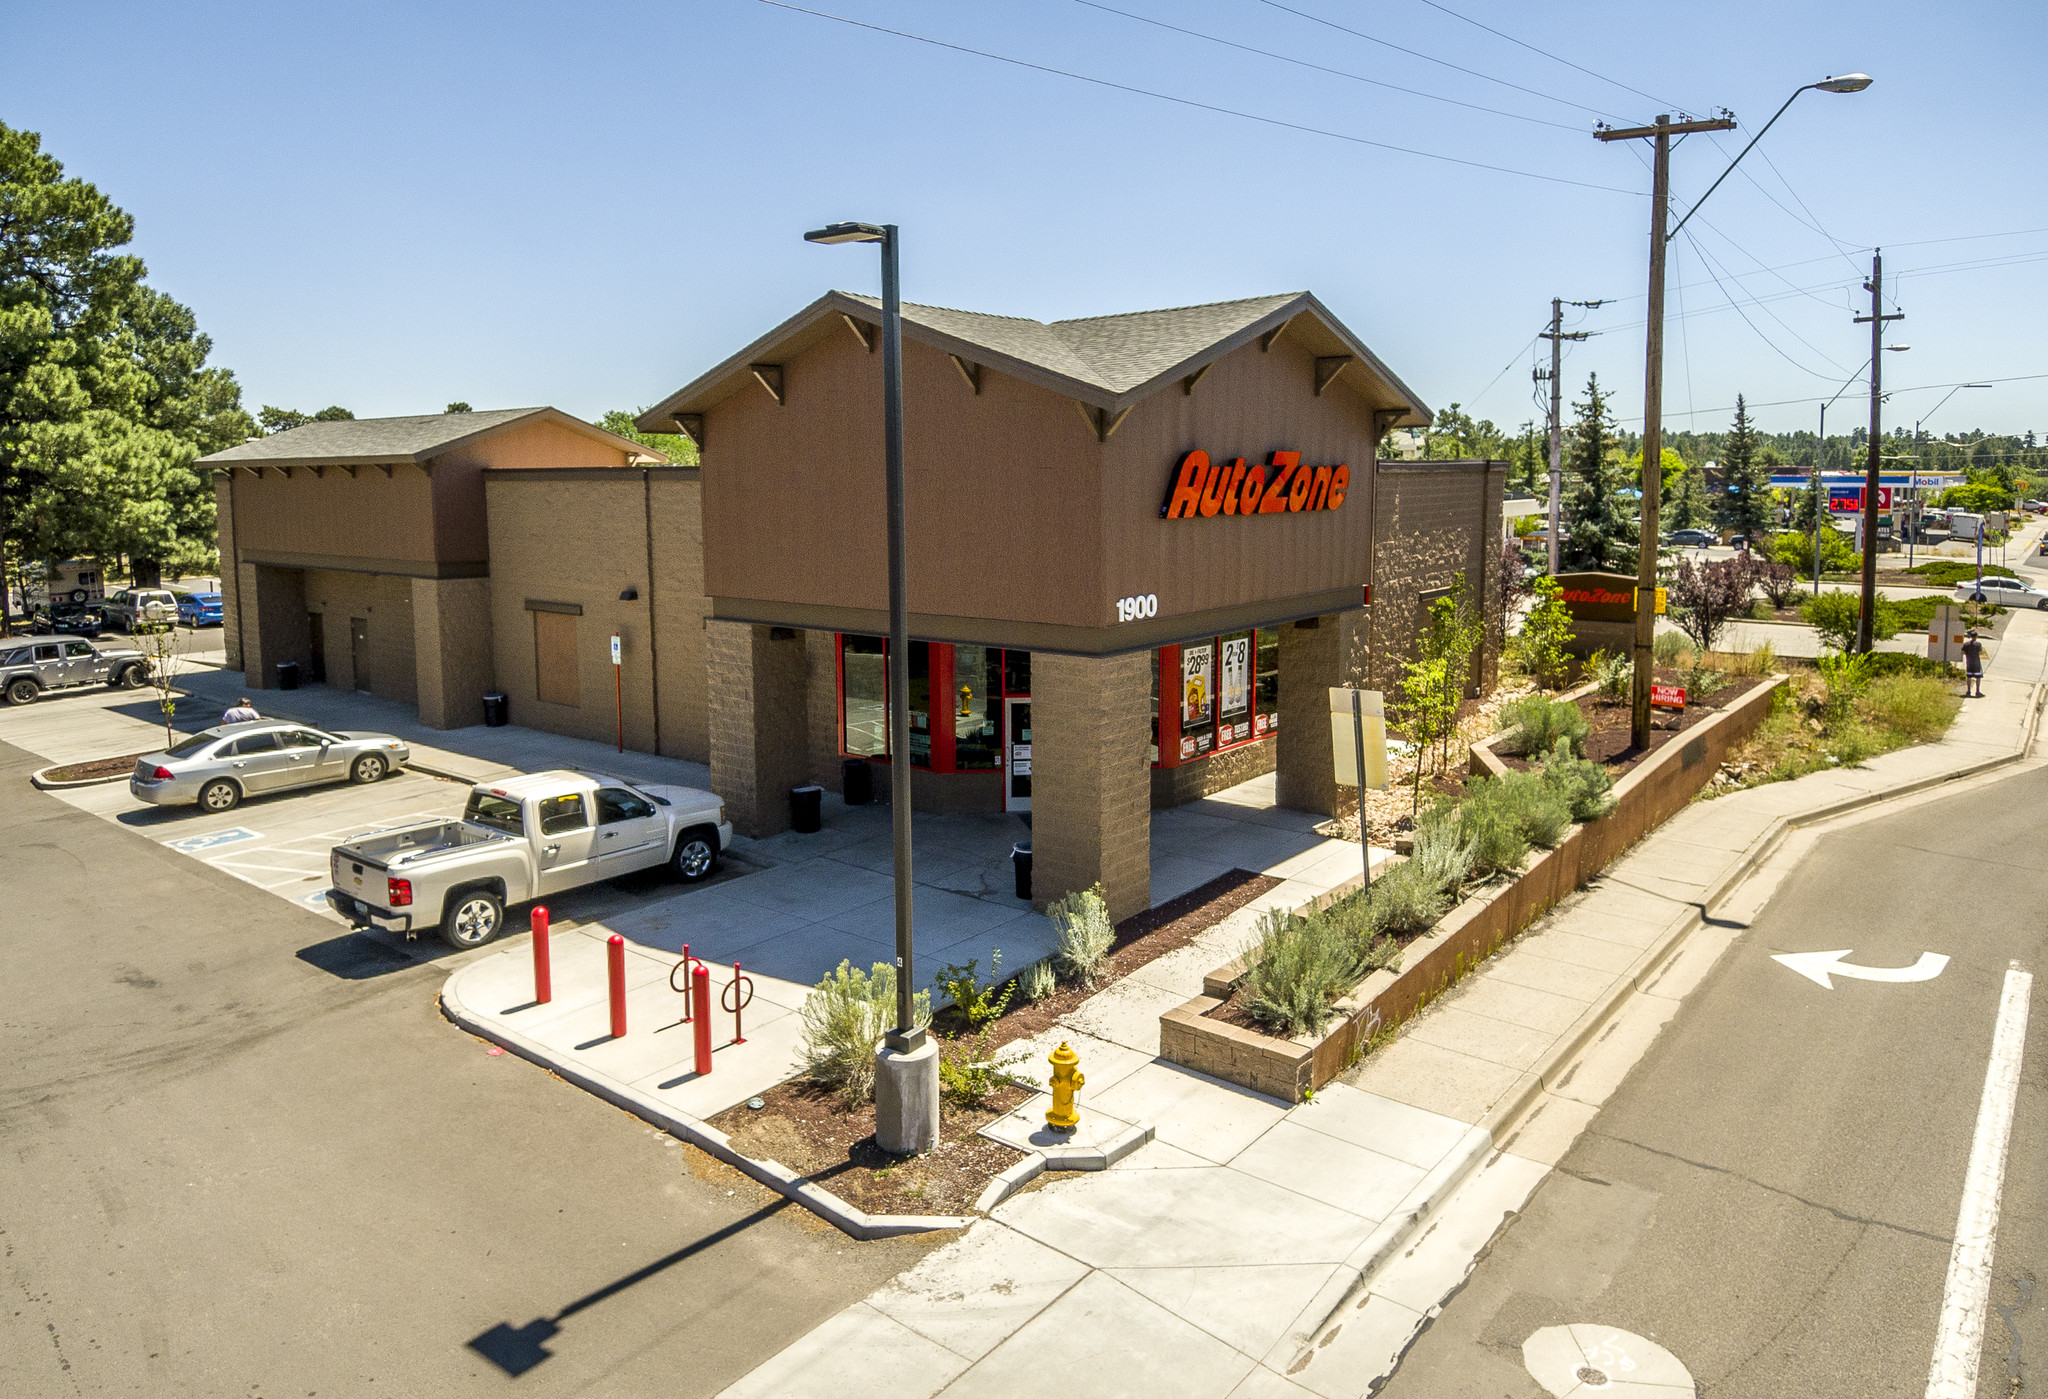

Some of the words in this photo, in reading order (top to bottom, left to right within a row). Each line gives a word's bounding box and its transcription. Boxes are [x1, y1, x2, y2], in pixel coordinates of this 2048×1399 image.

[1166, 450, 1350, 519] AutoZone
[1914, 478, 1939, 486] Mobil
[1116, 593, 1158, 622] 1900
[1225, 643, 1234, 666] 2
[1656, 686, 1679, 696] NOW
[1651, 693, 1683, 704] HIRING
[1221, 728, 1232, 742] FREE
